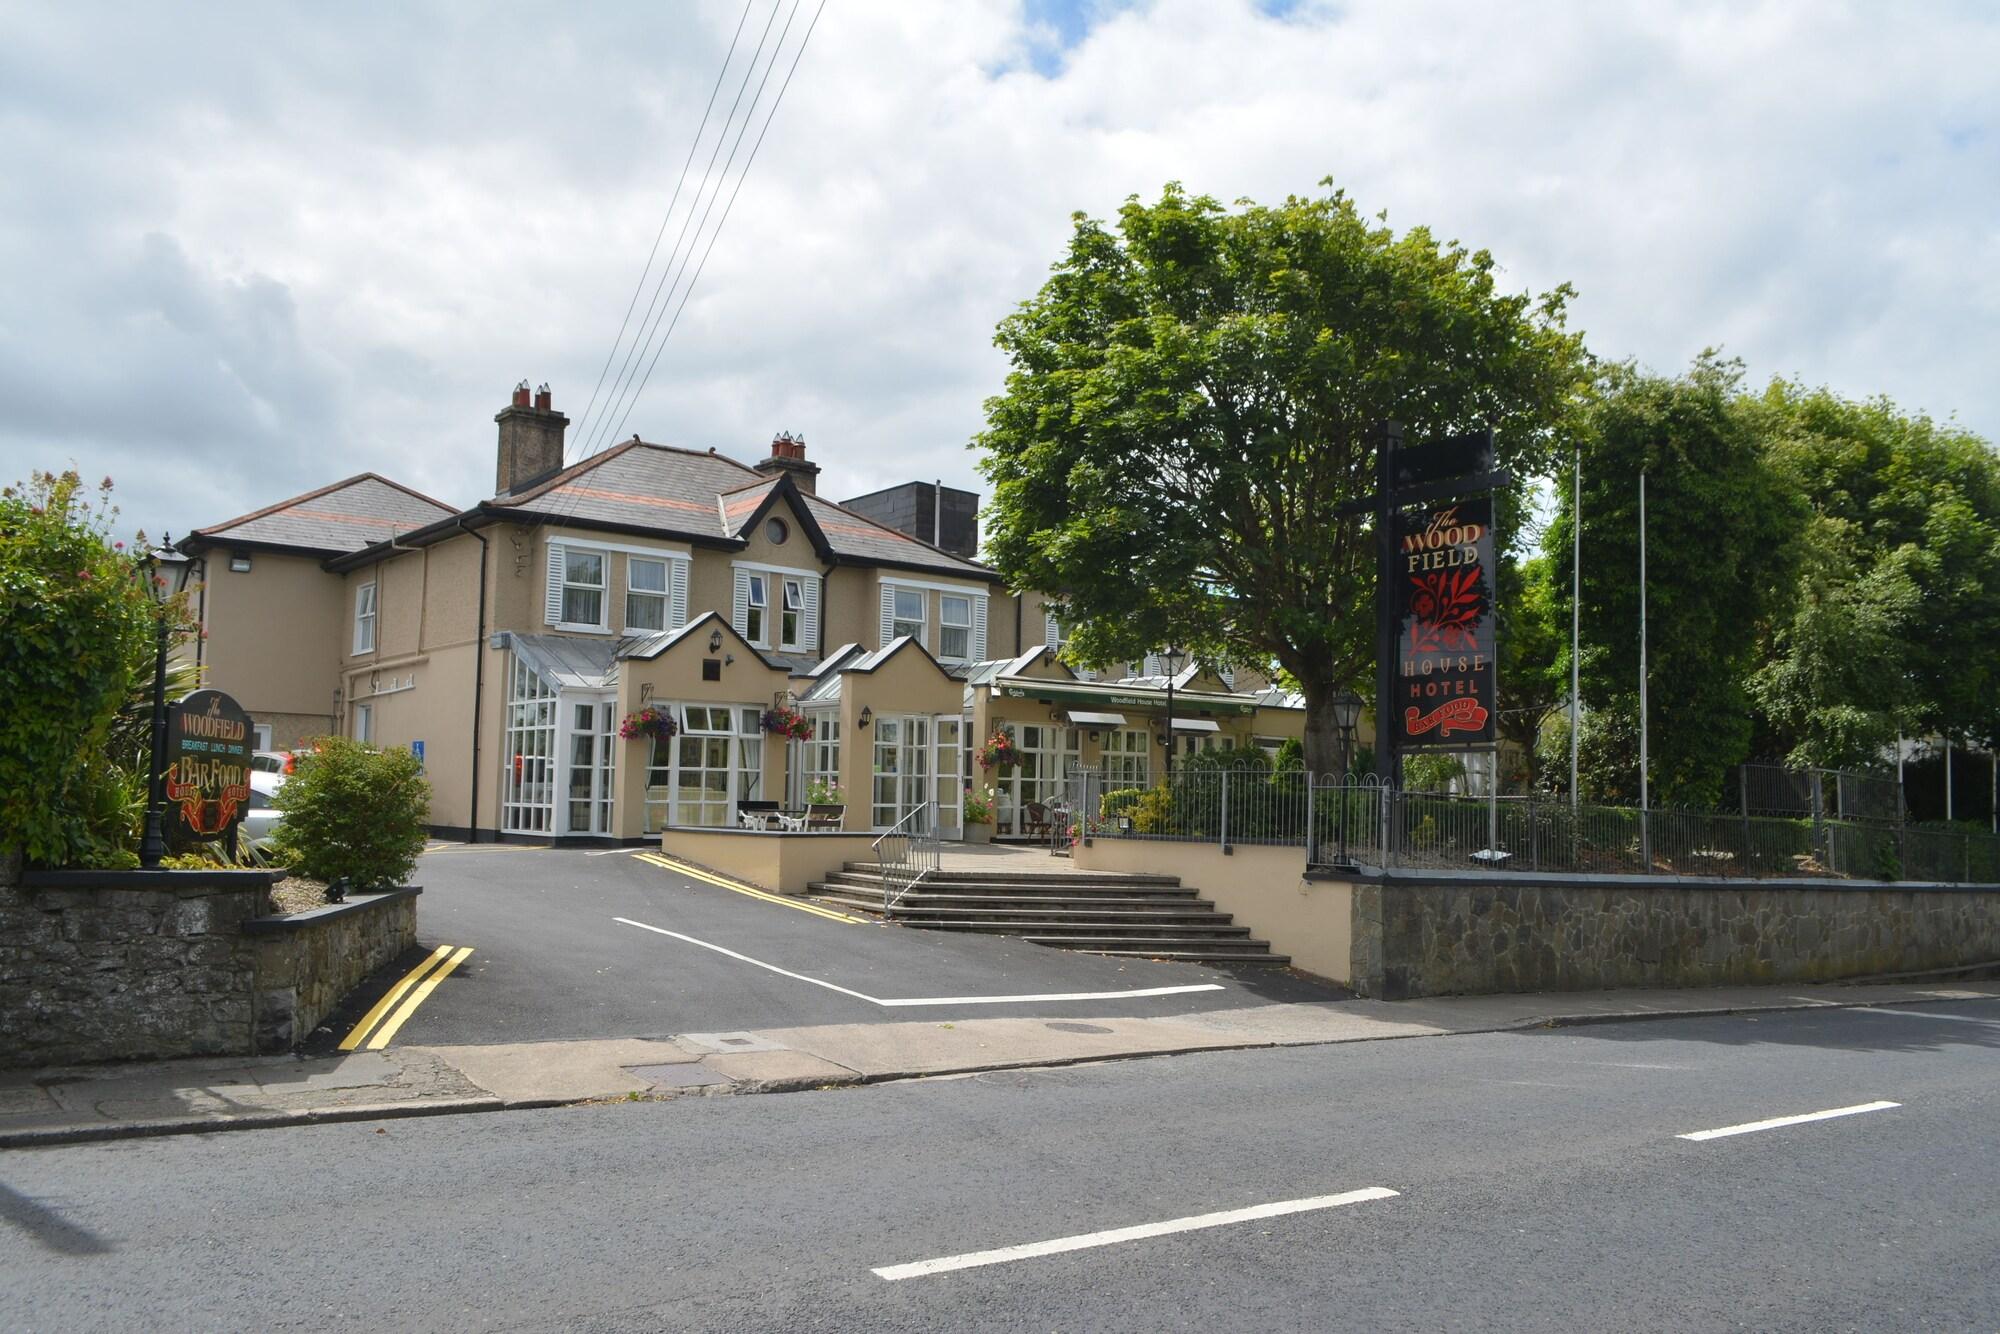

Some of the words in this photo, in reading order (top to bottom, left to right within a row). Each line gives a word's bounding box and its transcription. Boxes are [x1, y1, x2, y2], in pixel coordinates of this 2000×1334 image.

[1426, 506, 1458, 538] The
[1405, 524, 1481, 554] WOOD
[1408, 546, 1478, 573] FIELD
[1404, 655, 1485, 678] HOUSE
[1110, 696, 1136, 705] Woodfield
[1137, 698, 1153, 706] House
[1153, 698, 1167, 706] Hotel
[1410, 680, 1479, 698] HOTEL
[183, 713, 245, 741] WOODFIELD
[182, 740, 209, 751] BREAKFAST
[210, 743, 226, 753] LUNCH
[227, 744, 244, 755] DINNER
